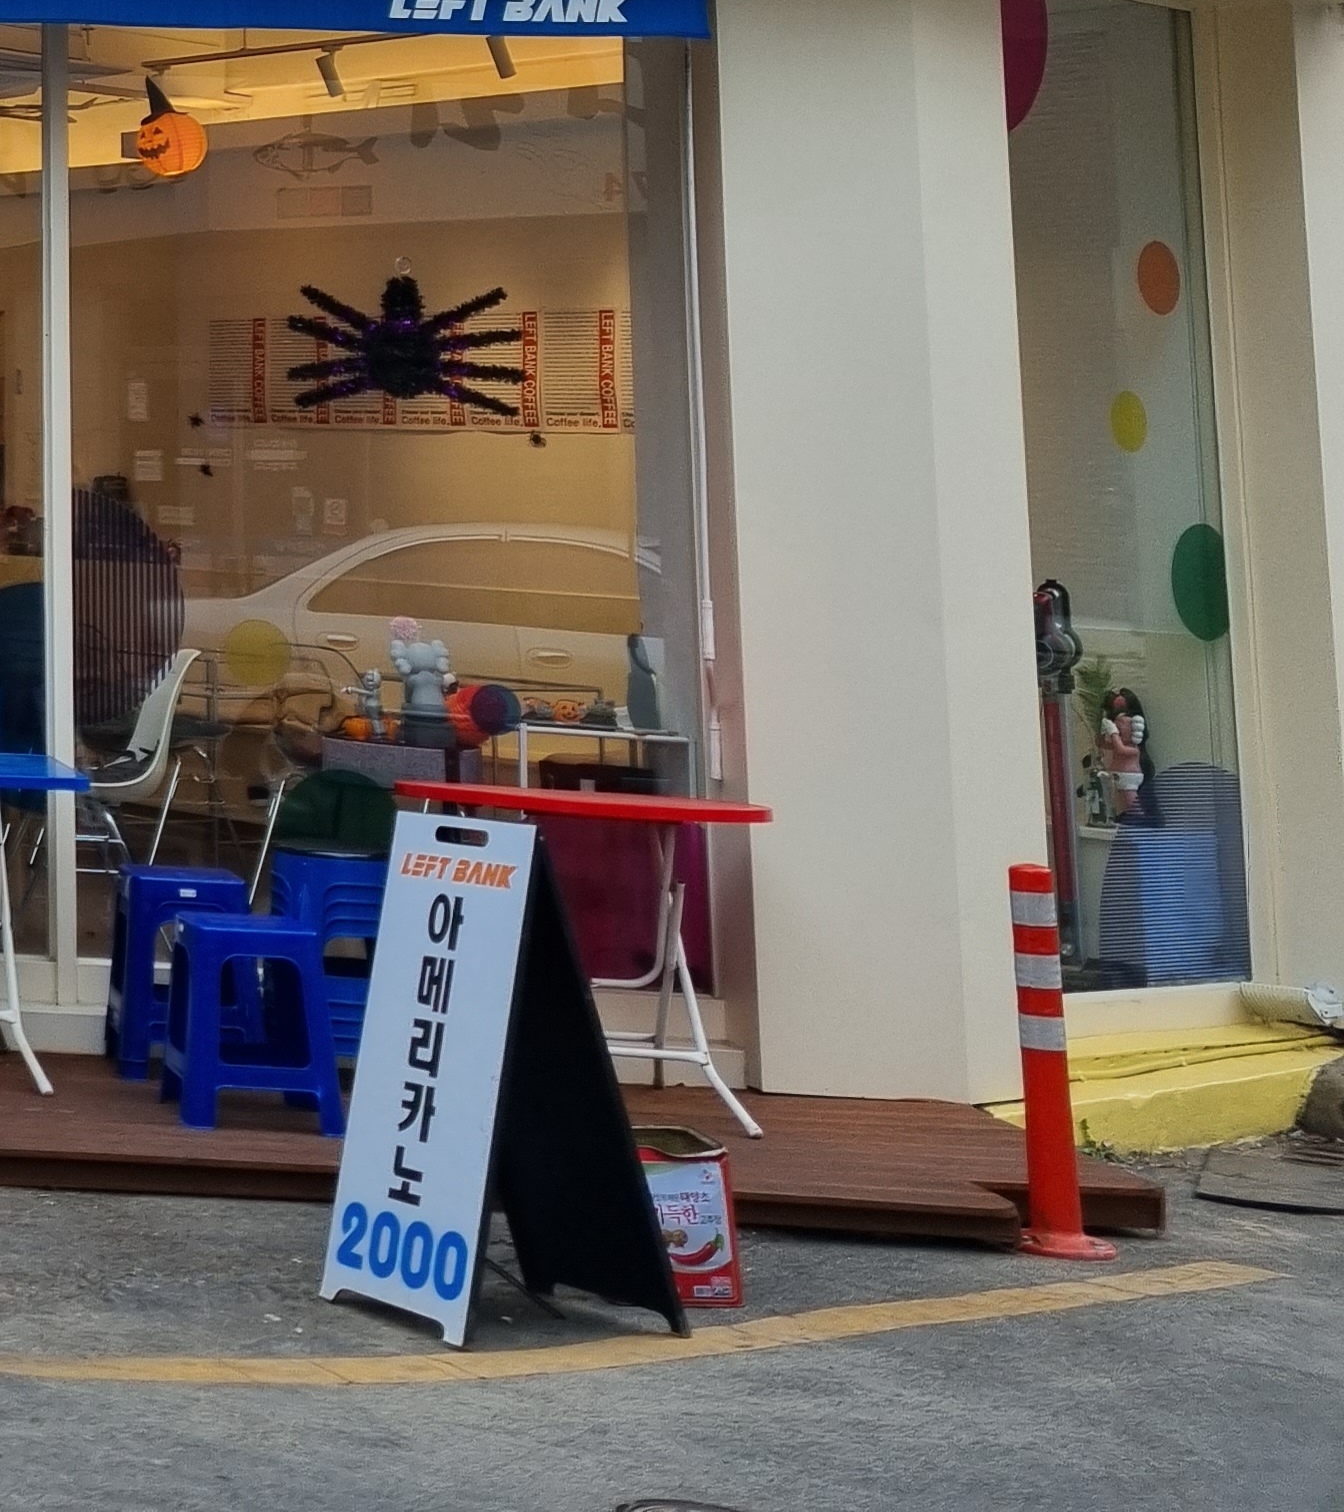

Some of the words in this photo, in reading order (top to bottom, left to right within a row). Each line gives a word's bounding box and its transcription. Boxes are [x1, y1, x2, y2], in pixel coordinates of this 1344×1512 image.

[523, 313, 537, 342] LEFT
[601, 312, 613, 342] LEFT
[524, 344, 537, 377] BANK
[601, 344, 615, 377] BANK
[523, 378, 538, 426] COFFEE
[601, 378, 617, 427] COFFEE
[546, 417, 580, 428] Coffee
[400, 852, 453, 880] LEFT
[451, 857, 518, 889] BANK
[386, 892, 465, 1208] 아메리카노
[336, 1201, 469, 1302] 2000
